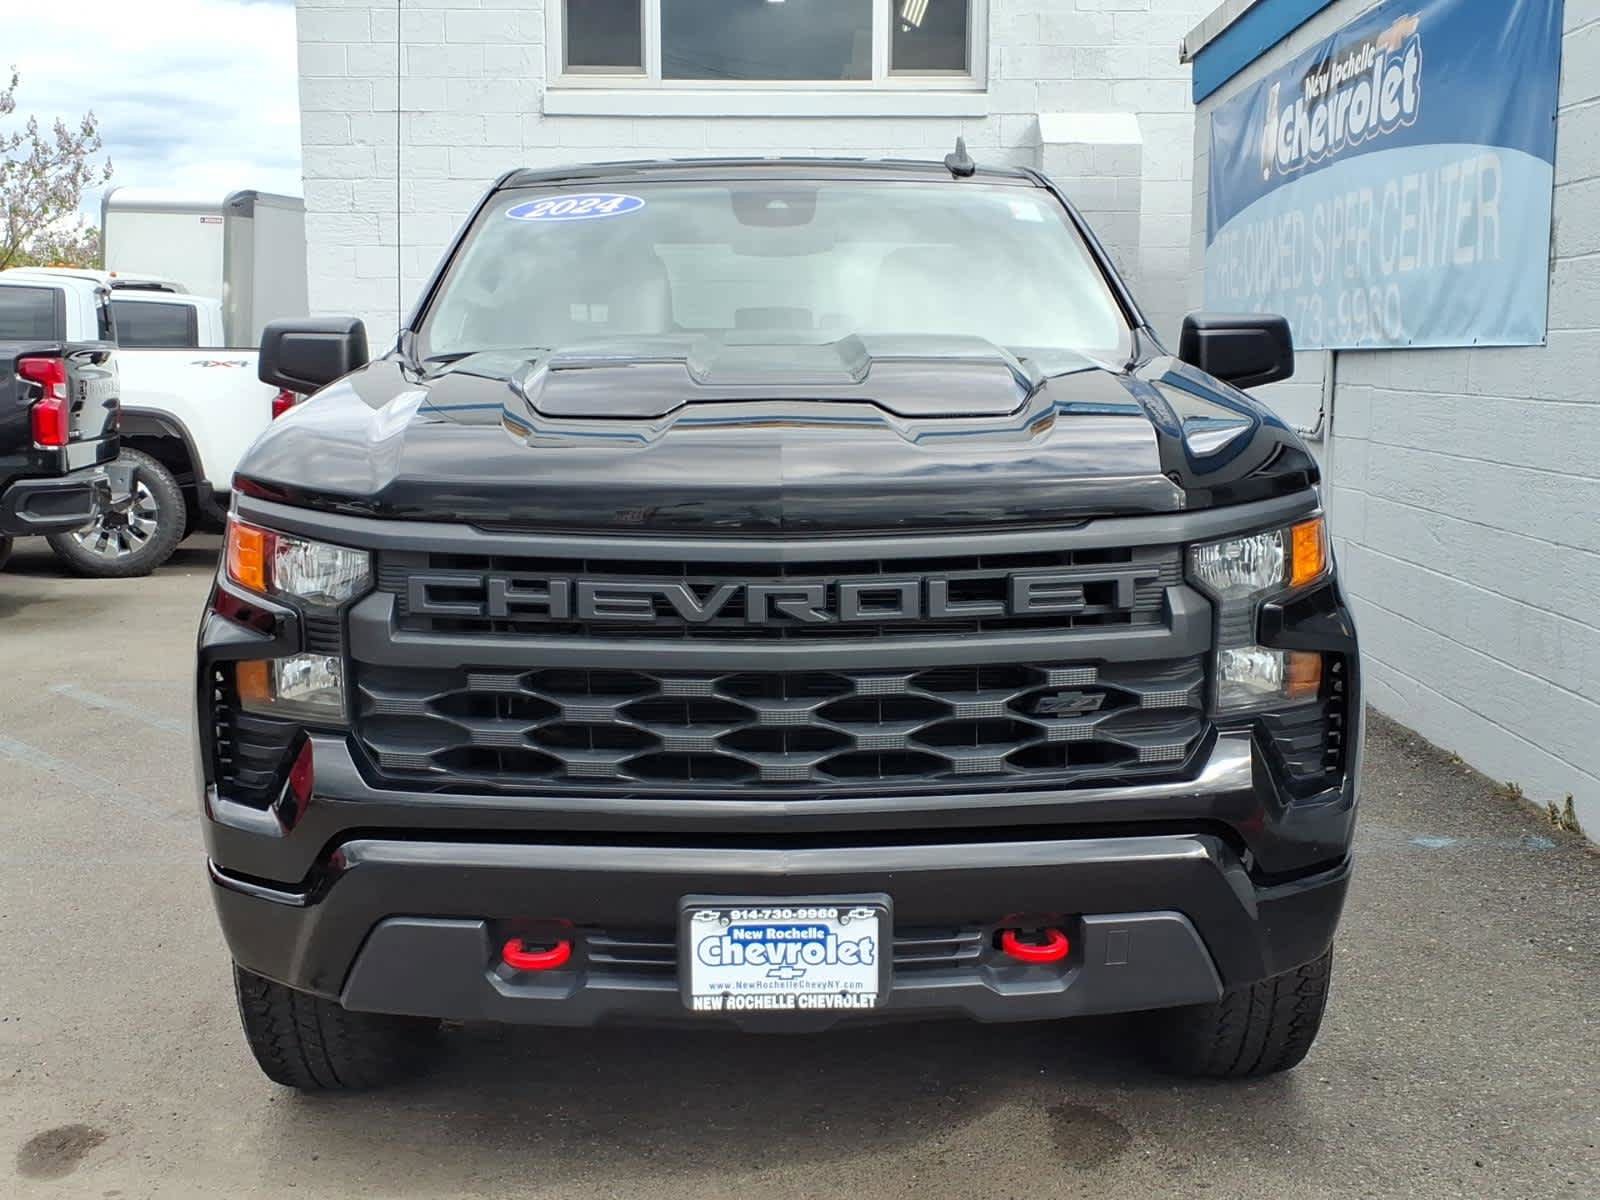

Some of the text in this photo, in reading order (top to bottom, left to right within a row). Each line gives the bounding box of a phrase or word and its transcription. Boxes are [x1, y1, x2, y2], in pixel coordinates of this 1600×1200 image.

[1305, 69, 1329, 101] New
[523, 196, 626, 218] 2024
[1381, 152, 1502, 276] CENTER
[407, 568, 1160, 625] CHEVROLET
[730, 908, 838, 920] 914-730-9960
[733, 927, 825, 940] New Rochelle
[698, 933, 875, 966] Chevrolet
[709, 980, 863, 991] www.NewRochelleChevyNY.com
[693, 993, 876, 1010] NEW ROCHELLE CHEVROLET
